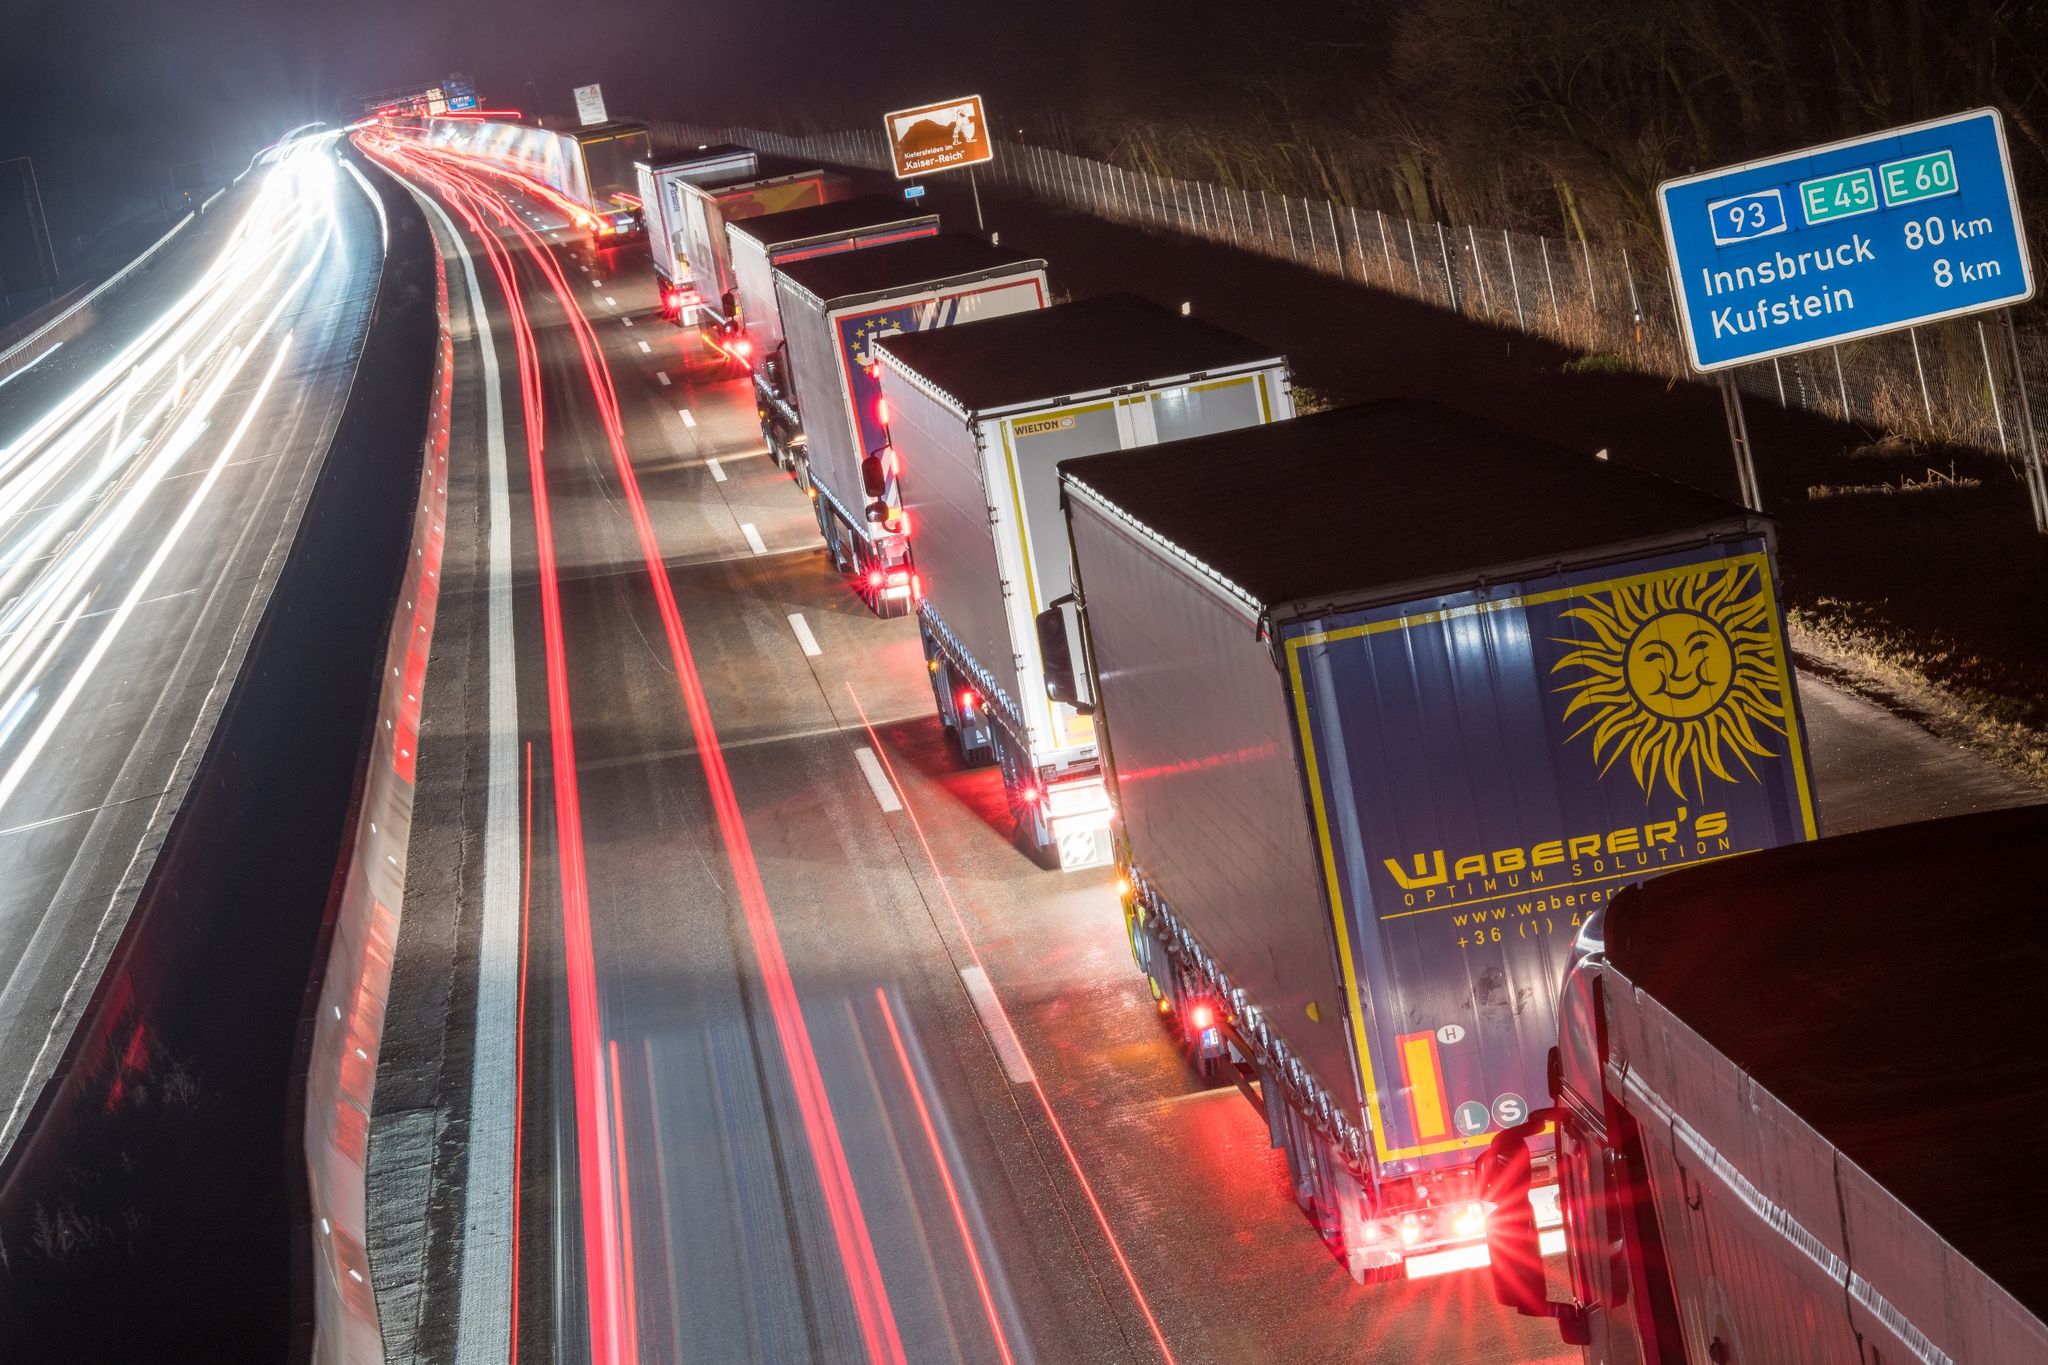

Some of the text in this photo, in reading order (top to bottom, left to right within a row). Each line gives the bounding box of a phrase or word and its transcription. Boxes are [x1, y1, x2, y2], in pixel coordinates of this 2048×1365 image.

[1887, 160, 1950, 197] E 60
[1808, 178, 1870, 215] E 45
[1729, 202, 1766, 233] 93
[1703, 216, 1993, 296] Innsbruck 80 km
[1711, 259, 2001, 339] Kufstein 8 km
[1014, 420, 1059, 435] WIELTON
[1383, 807, 1728, 890] WABERER'S
[1404, 837, 1731, 906] OPTIMUM SOLUTION
[1457, 926, 1502, 948] +36
[1519, 917, 1553, 940] (1)
[1445, 1027, 1456, 1040] H
[1463, 1108, 1481, 1131] L
[1499, 1099, 1521, 1121] S
